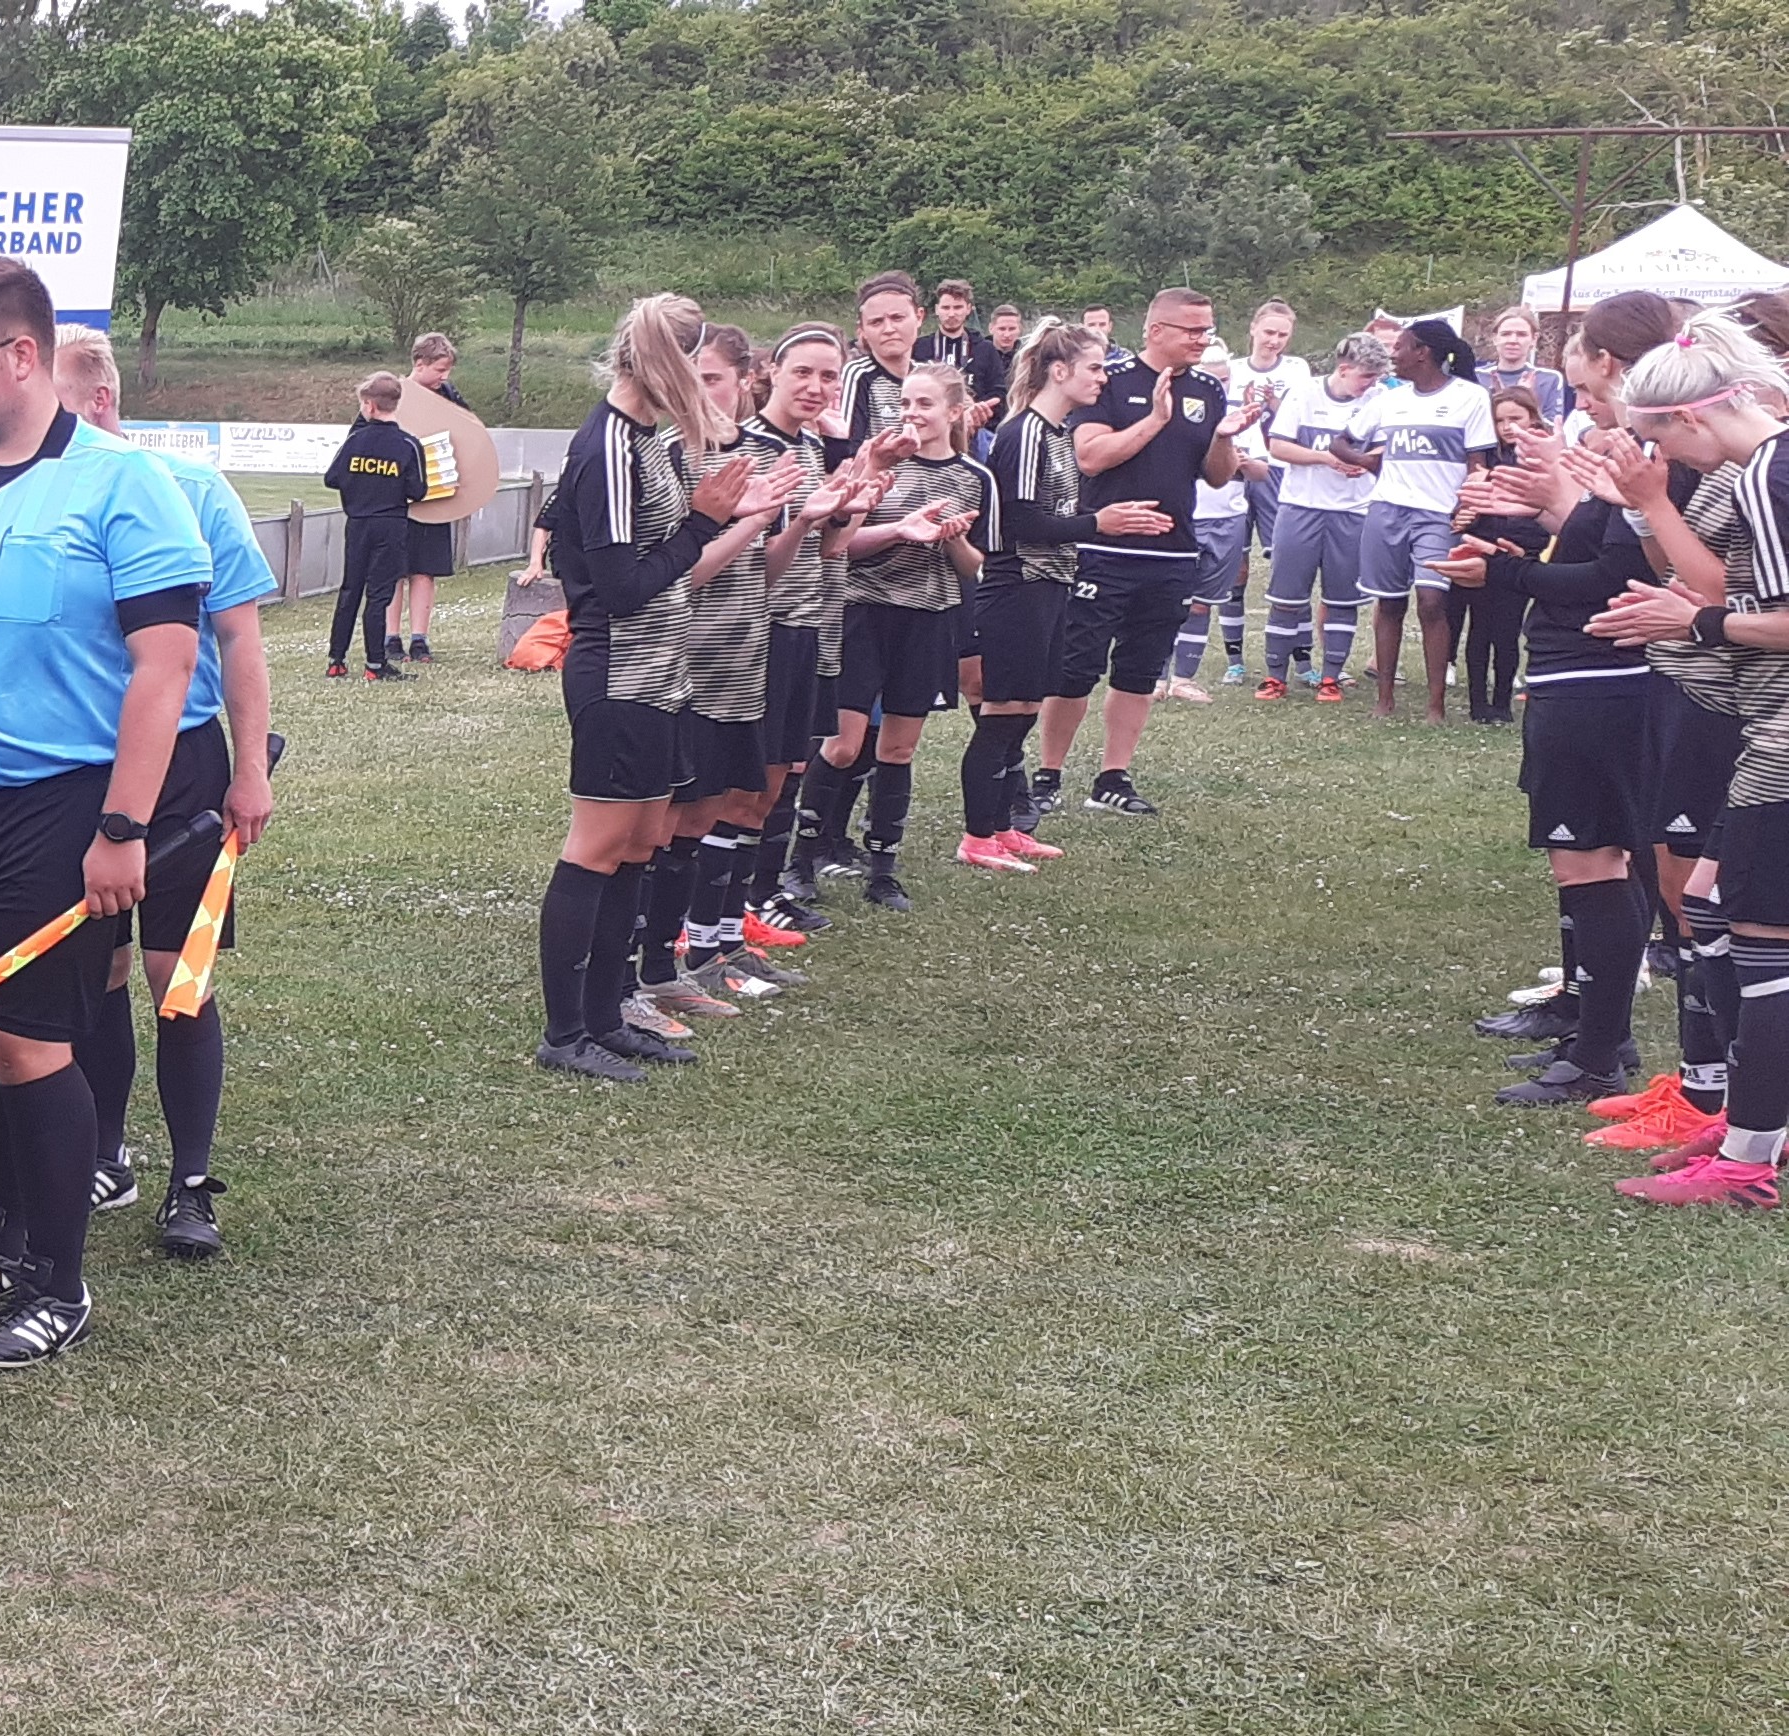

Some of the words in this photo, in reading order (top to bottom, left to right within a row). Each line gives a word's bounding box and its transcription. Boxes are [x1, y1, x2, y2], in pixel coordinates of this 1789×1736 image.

[139, 433, 167, 448] DEIN
[169, 433, 204, 449] LEBEN
[229, 426, 295, 441] WILD
[1391, 428, 1434, 455] Mia
[349, 456, 400, 478] EICHA
[1074, 581, 1098, 600] 22
